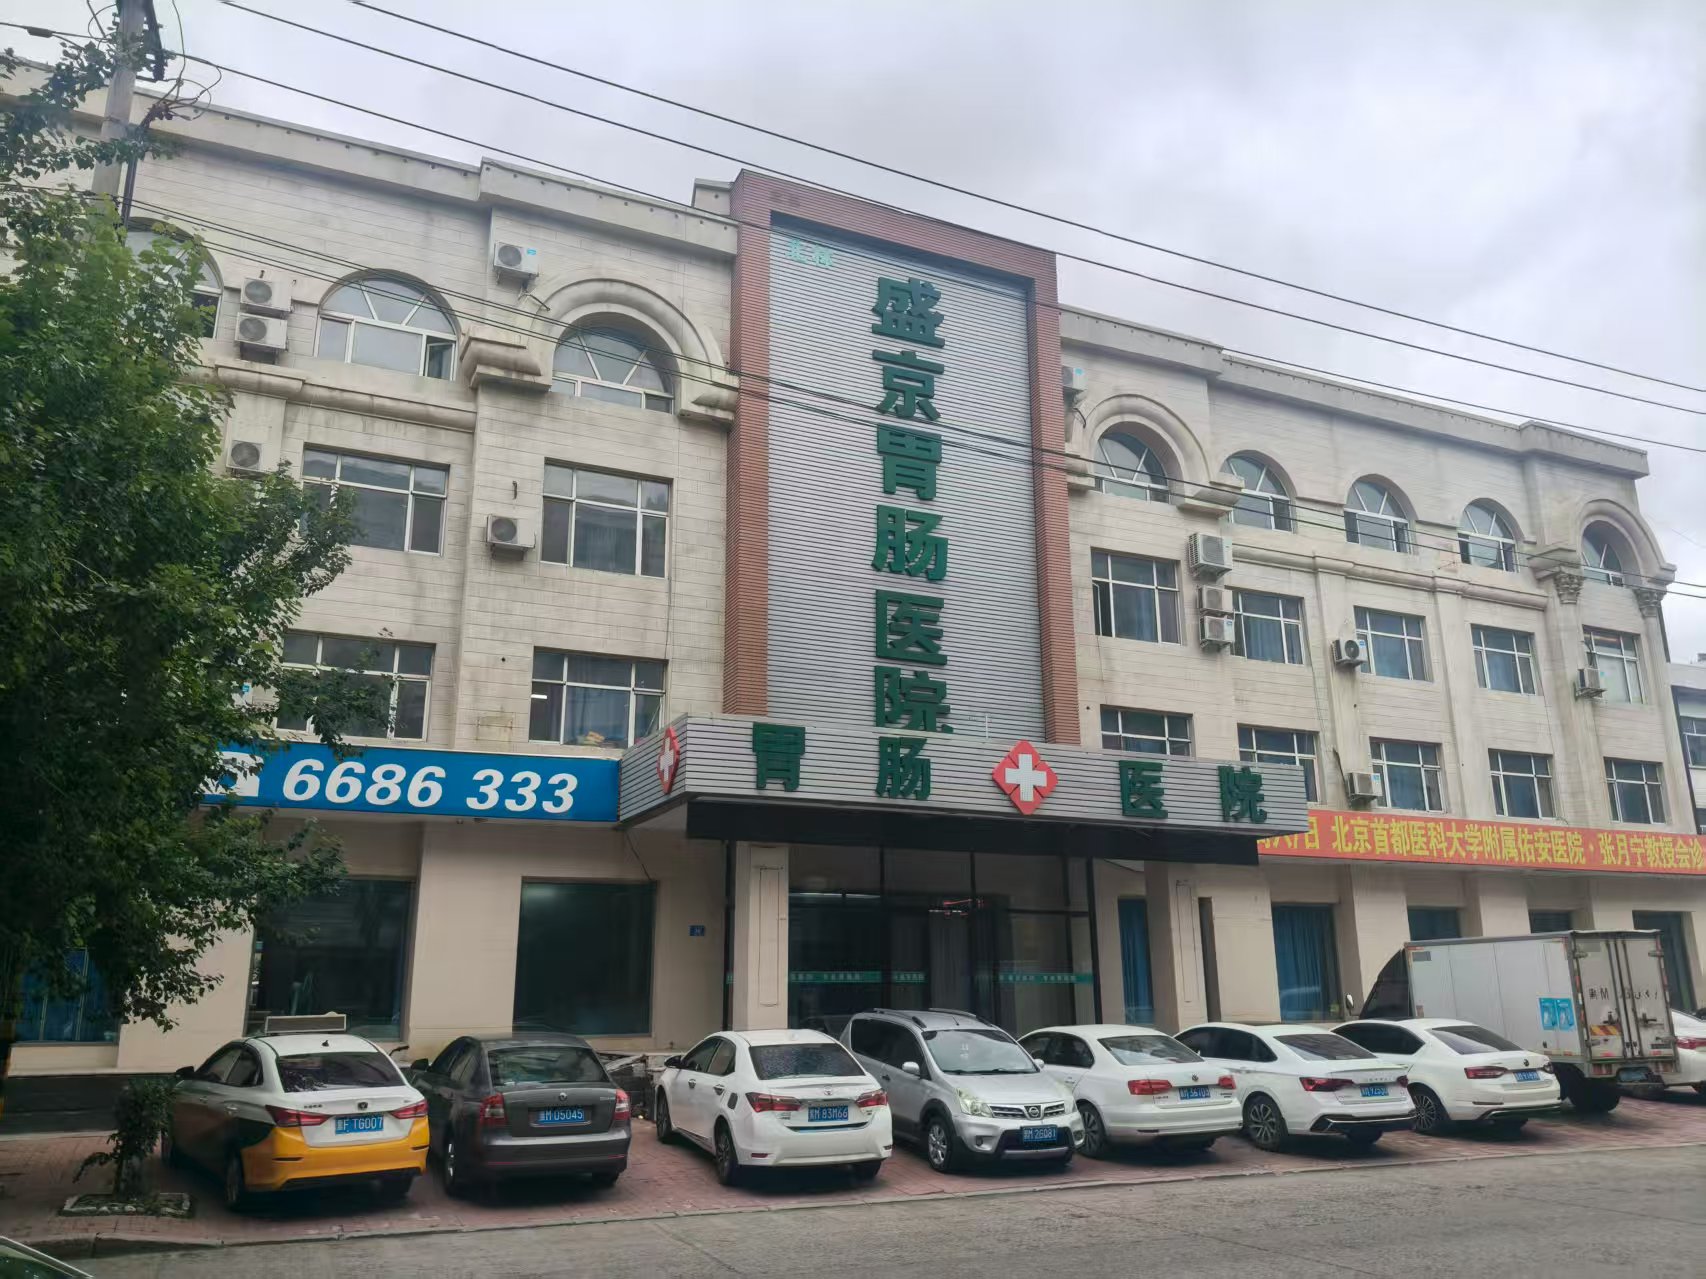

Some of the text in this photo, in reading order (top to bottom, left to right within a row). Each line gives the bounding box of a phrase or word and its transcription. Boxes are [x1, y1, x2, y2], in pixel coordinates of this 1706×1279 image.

[872, 277, 954, 734] 盛京胃肠医院
[282, 758, 578, 814] 6686 333
